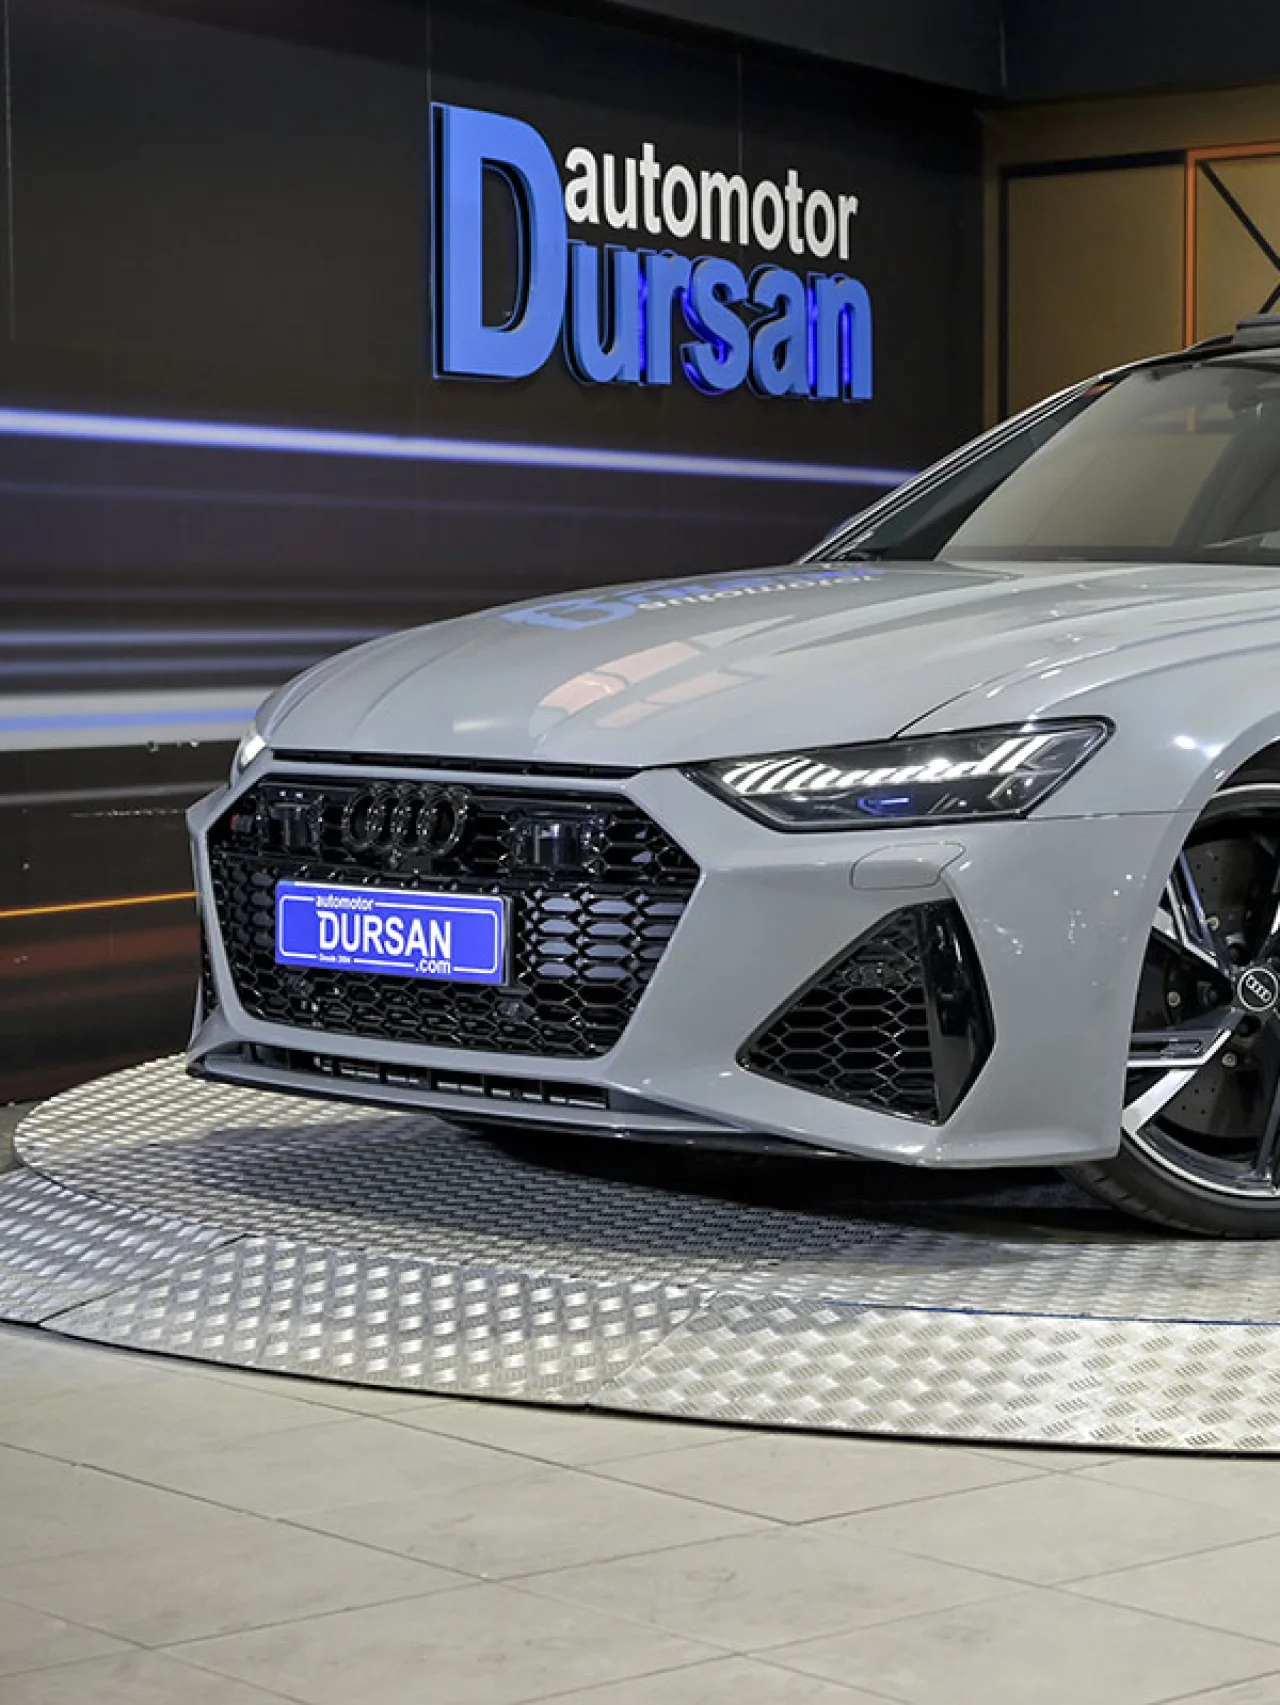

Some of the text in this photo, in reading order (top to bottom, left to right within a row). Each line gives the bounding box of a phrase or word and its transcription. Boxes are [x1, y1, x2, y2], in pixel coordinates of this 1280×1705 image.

[564, 142, 858, 260] automotor
[431, 102, 873, 401] Dursan
[316, 894, 374, 911] automotor
[316, 910, 451, 959] DURSAN
[416, 958, 451, 974] .com
